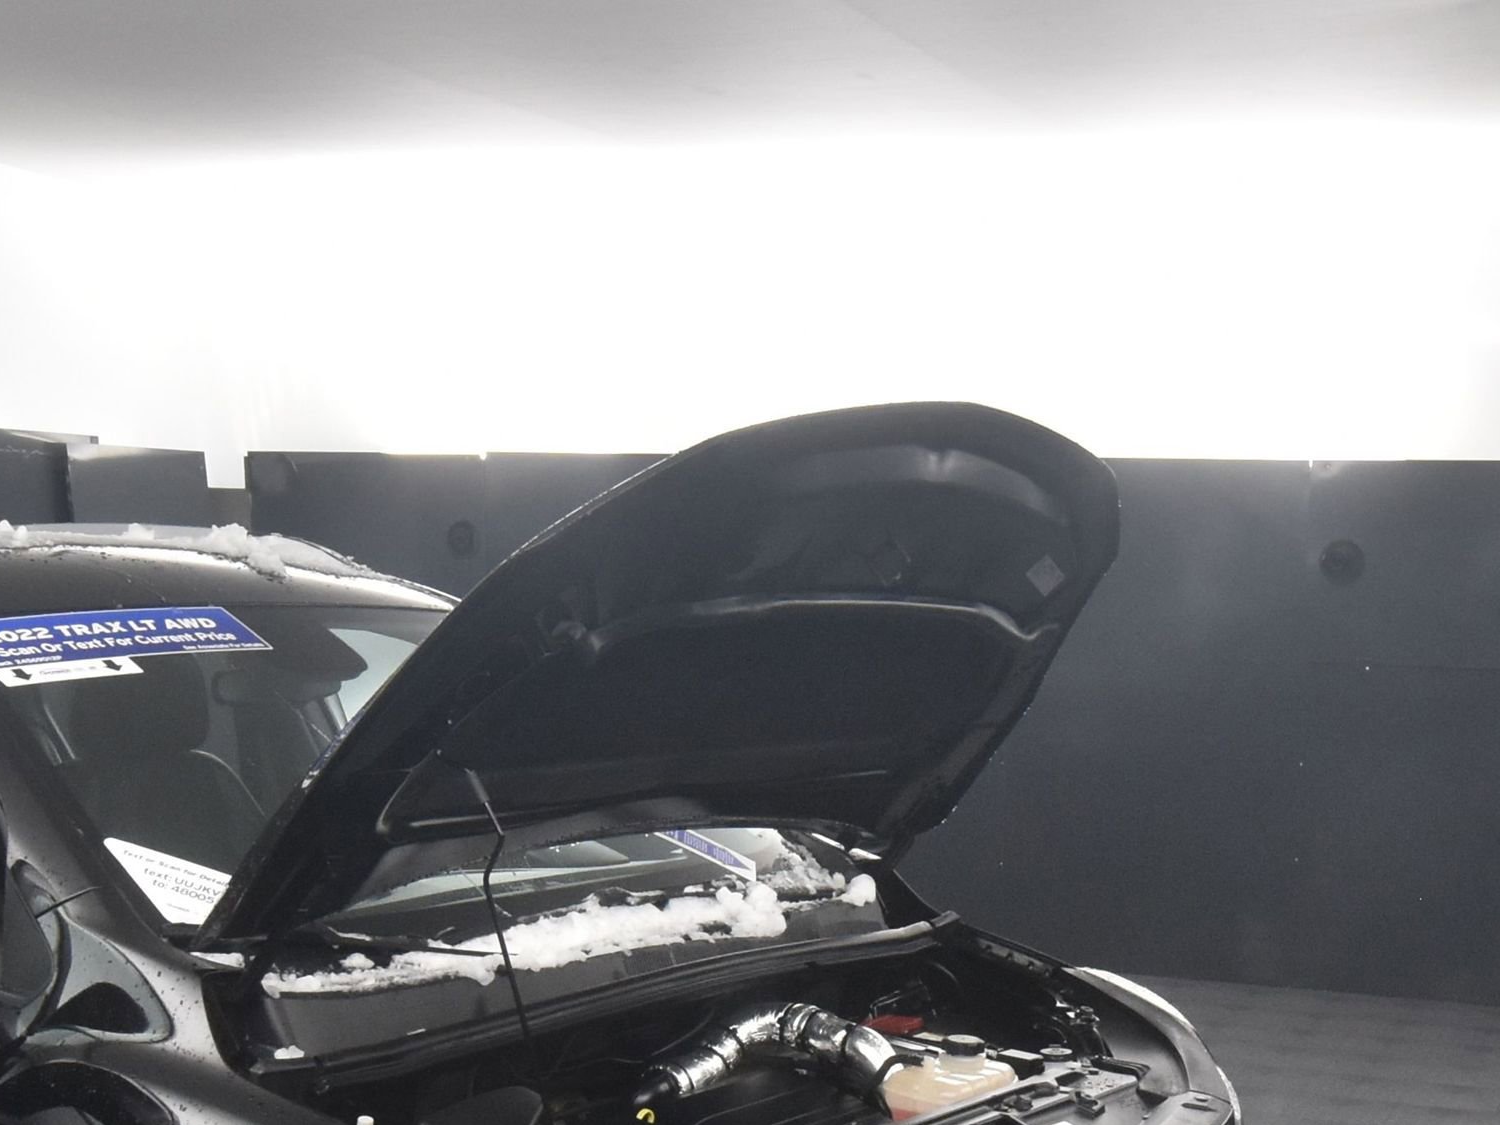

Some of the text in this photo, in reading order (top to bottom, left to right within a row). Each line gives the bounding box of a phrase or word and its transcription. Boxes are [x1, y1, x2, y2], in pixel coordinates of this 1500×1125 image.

[53, 621, 127, 637] TRAX
[127, 619, 156, 631] LT
[164, 617, 217, 629] AWD
[41, 643, 63, 652] Or
[63, 639, 106, 650] Text
[104, 636, 134, 647] For
[134, 633, 197, 644] Current
[195, 632, 237, 641] Price
[171, 886, 215, 904] 48005
